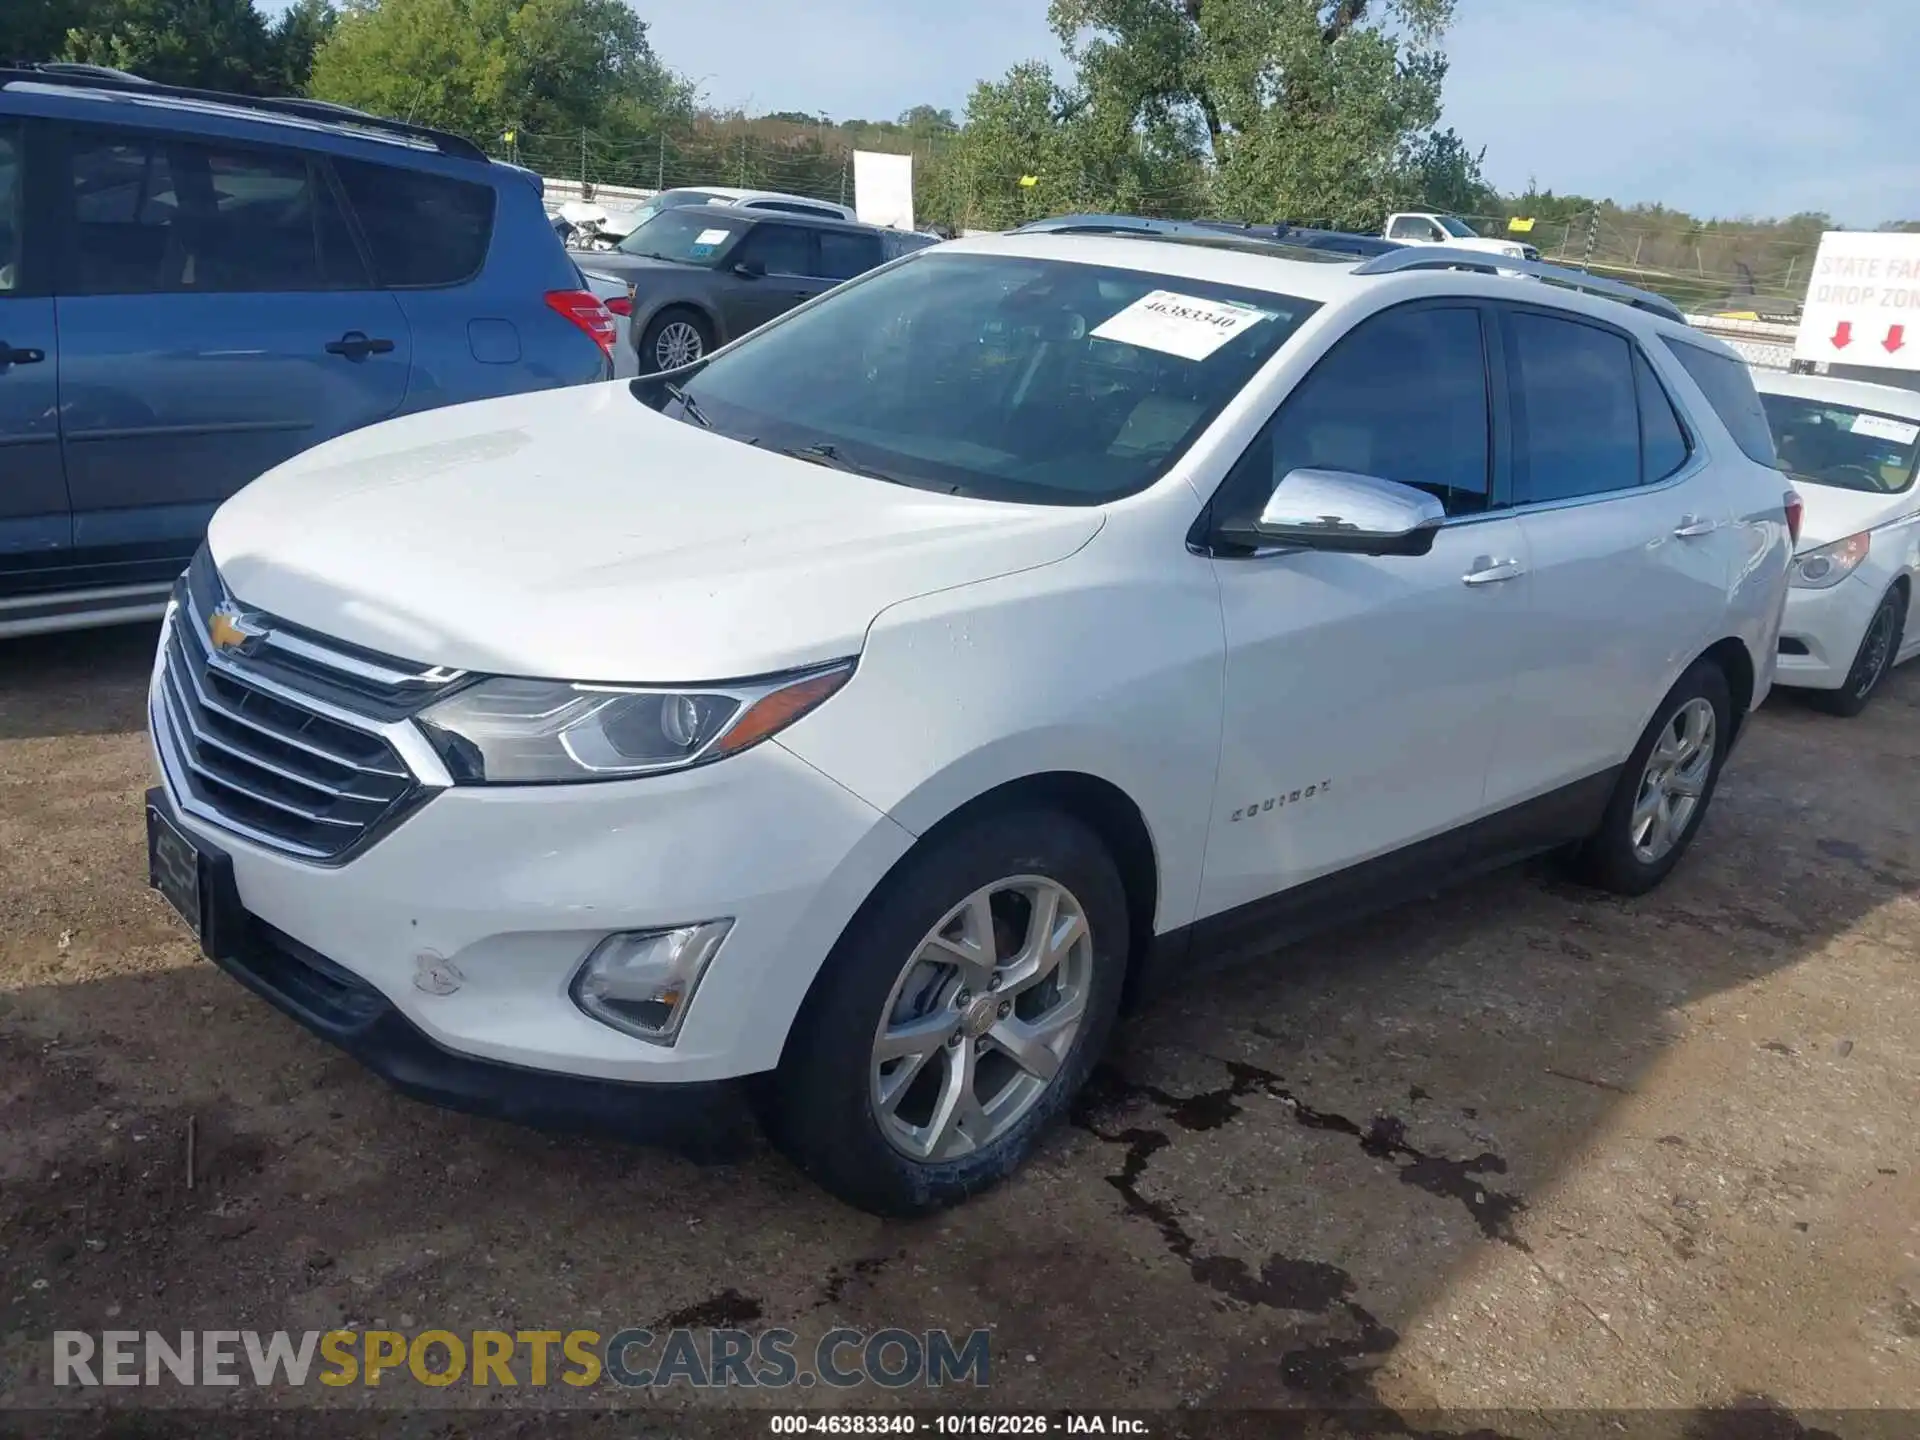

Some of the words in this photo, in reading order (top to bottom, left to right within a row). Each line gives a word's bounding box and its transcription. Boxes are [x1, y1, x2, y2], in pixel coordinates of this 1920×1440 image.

[1819, 256, 1882, 278] STATE
[1816, 285, 1875, 306] DROP
[1144, 301, 1237, 329] 46383340
[1230, 778, 1332, 822] EQUINOX
